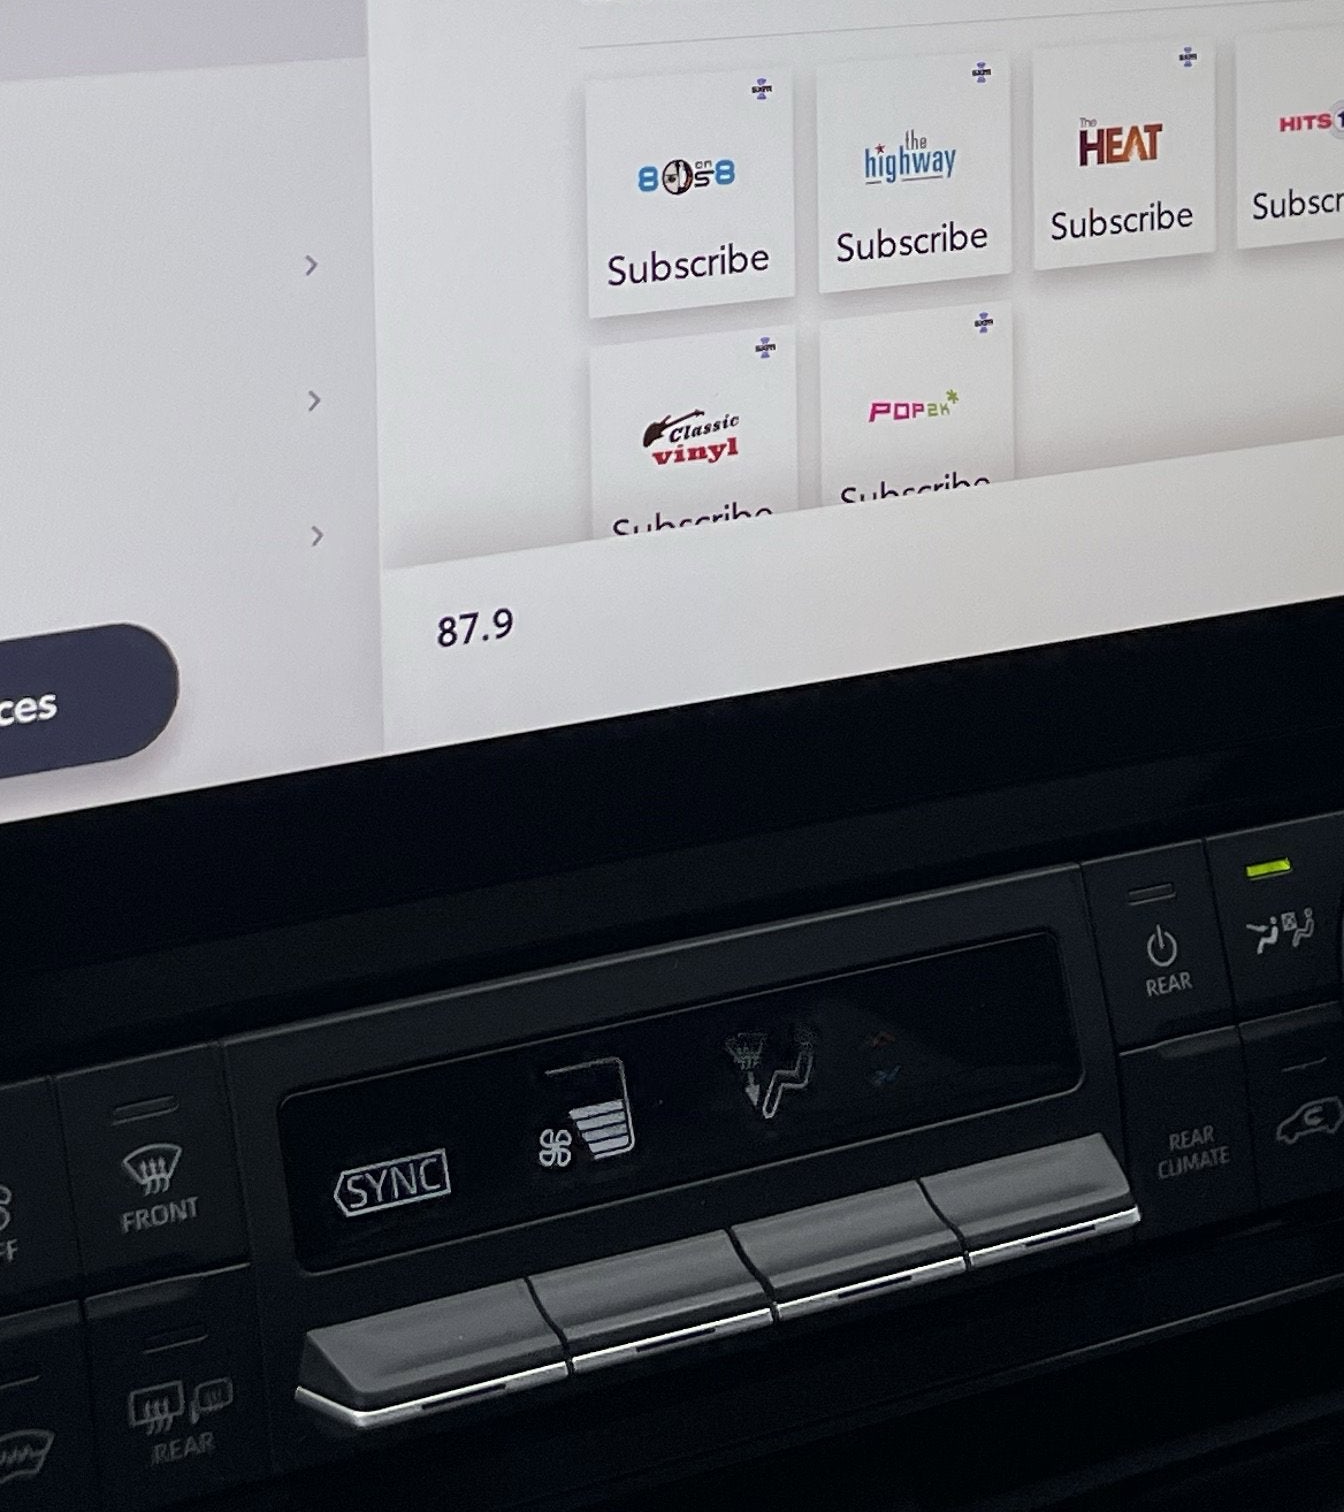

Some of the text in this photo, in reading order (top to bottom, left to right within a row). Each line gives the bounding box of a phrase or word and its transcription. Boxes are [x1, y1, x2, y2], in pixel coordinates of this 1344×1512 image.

[904, 129, 927, 150] the
[1079, 123, 1163, 167] HEAT
[864, 143, 957, 184] highway
[1051, 200, 1193, 241] Subscribe
[837, 220, 988, 263] Subscribe
[608, 242, 770, 286] Subscribe
[669, 413, 740, 445] Classic
[651, 436, 739, 466] vinyl
[437, 608, 514, 648] 87.9
[1145, 971, 1193, 997] REAR
[1168, 1125, 1215, 1150] REAR
[1158, 1145, 1230, 1179] CLIMATE
[347, 1160, 441, 1209] SYNC
[122, 1197, 200, 1234] FRONT
[151, 1430, 216, 1465] REAR
